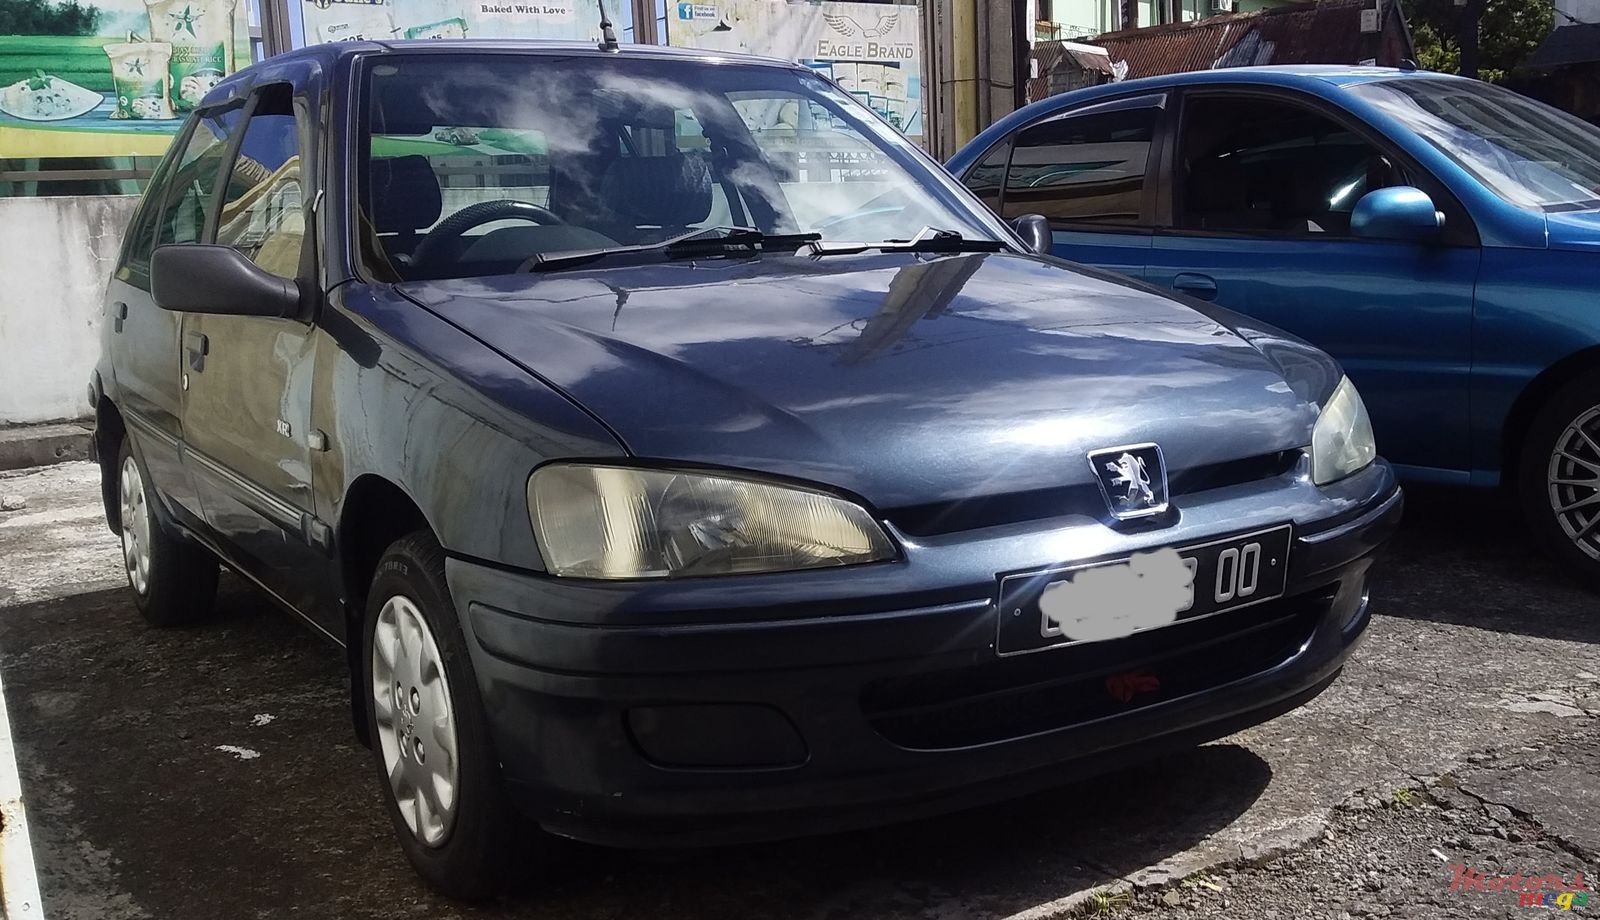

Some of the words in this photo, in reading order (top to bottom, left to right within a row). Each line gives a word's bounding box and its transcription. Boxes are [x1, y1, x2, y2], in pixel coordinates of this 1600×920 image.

[481, 5, 512, 13] Baked
[515, 6, 540, 14] With
[543, 6, 566, 14] Love
